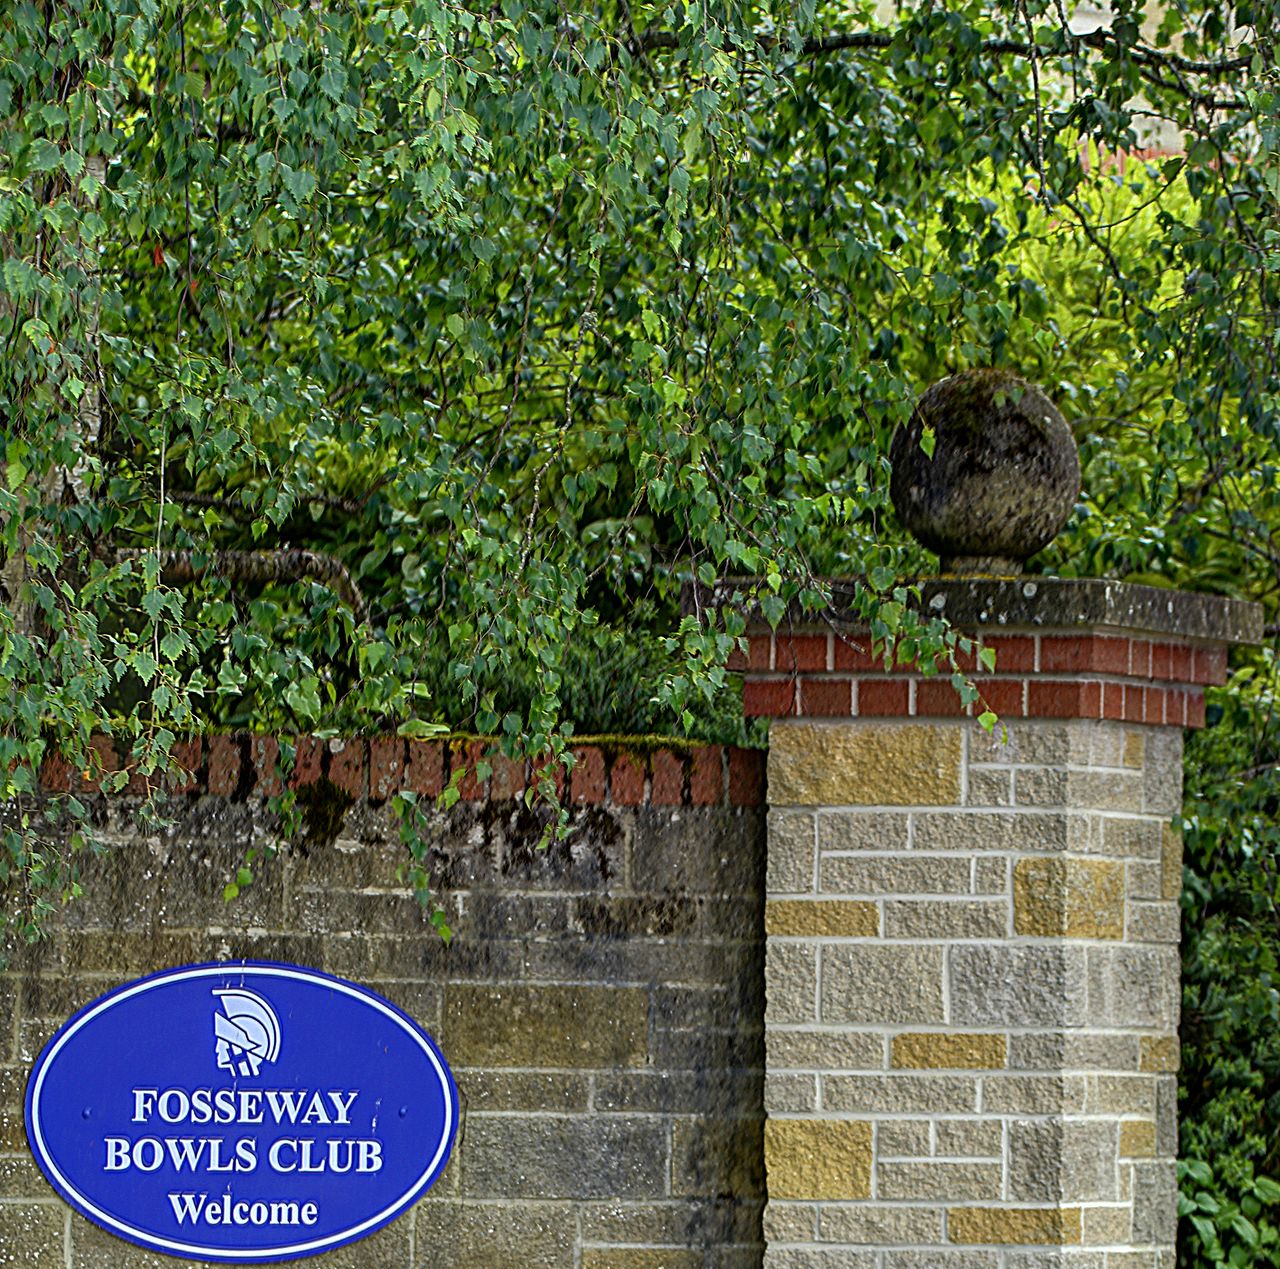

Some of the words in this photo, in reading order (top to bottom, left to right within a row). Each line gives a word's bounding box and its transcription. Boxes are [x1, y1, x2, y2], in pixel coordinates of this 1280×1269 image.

[131, 1088, 359, 1124] FOSSEWAY
[103, 1137, 257, 1172] BOWLS
[268, 1139, 383, 1173] CLUB
[167, 1192, 318, 1226] Welcome
